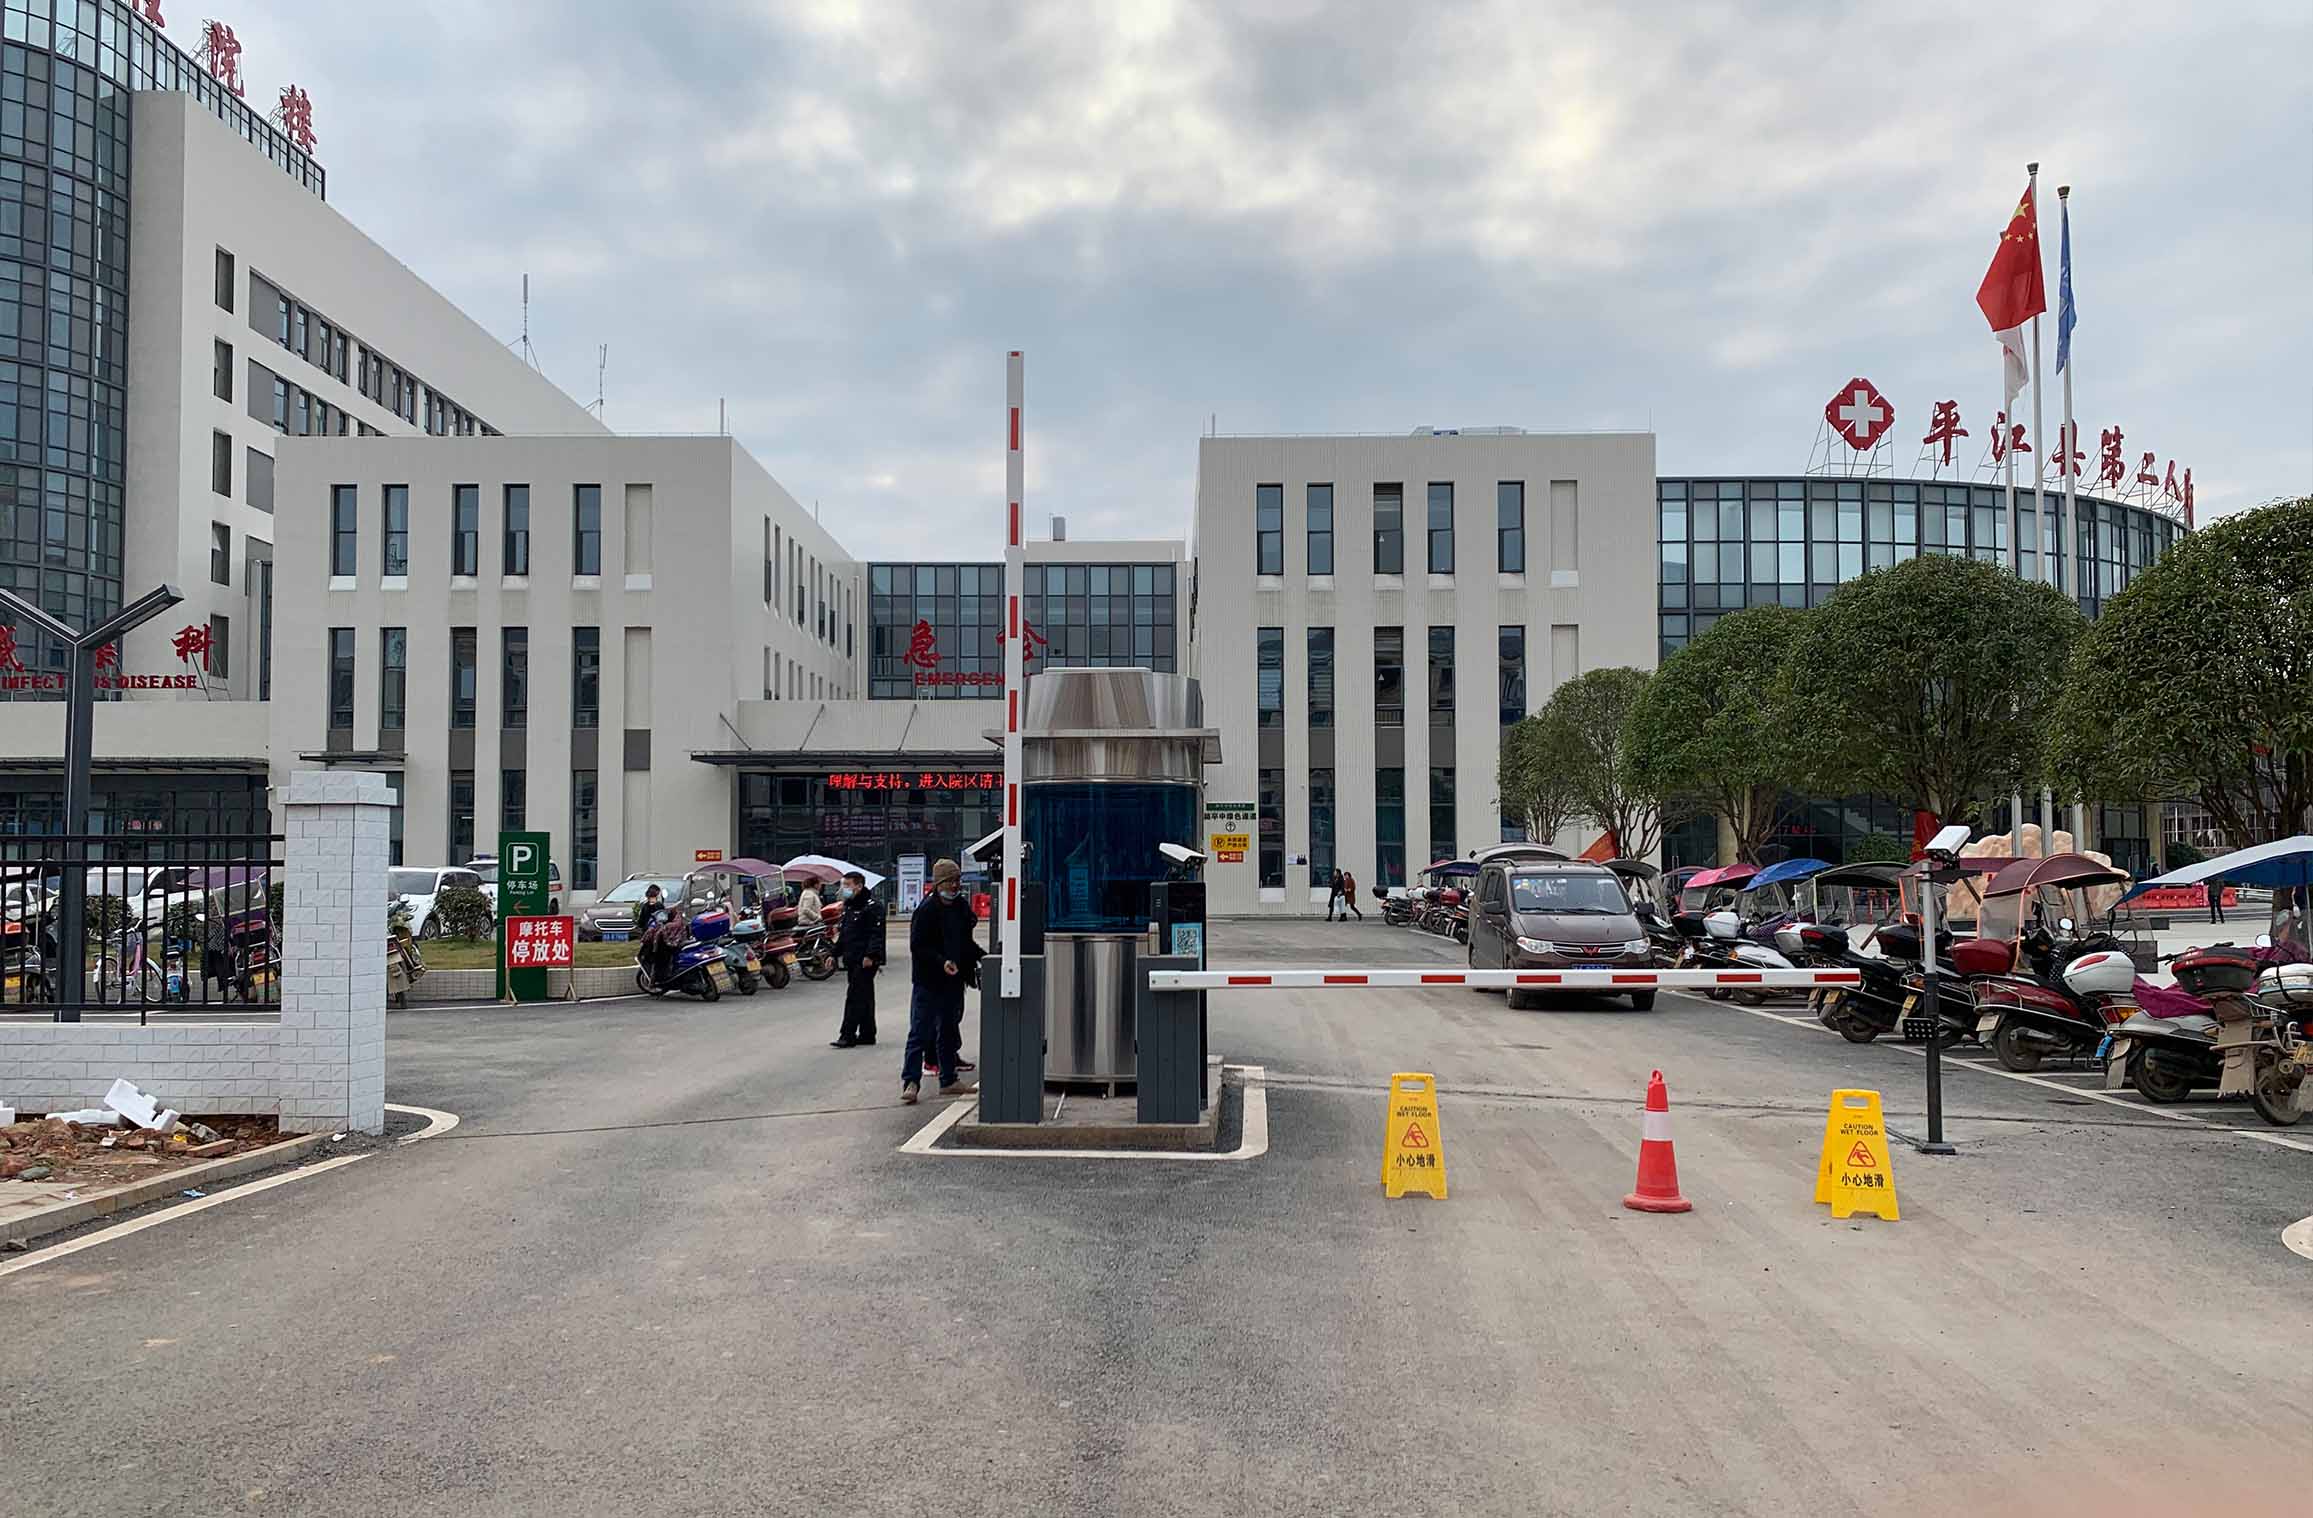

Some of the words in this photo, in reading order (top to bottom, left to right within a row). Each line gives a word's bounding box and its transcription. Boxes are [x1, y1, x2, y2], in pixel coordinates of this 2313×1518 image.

[1, 674, 111, 689] INFECTS
[118, 674, 197, 689] DISEASE
[914, 671, 1031, 686] EMERGEN
[512, 845, 533, 873] P
[506, 880, 539, 890] 停车场
[519, 921, 563, 937] 摩托车
[511, 939, 570, 964] 停放处
[1856, 1129, 1879, 1137] FLOOR
[1396, 1153, 1436, 1168] 小心地滑
[1841, 1172, 1884, 1188] 小心地滑
